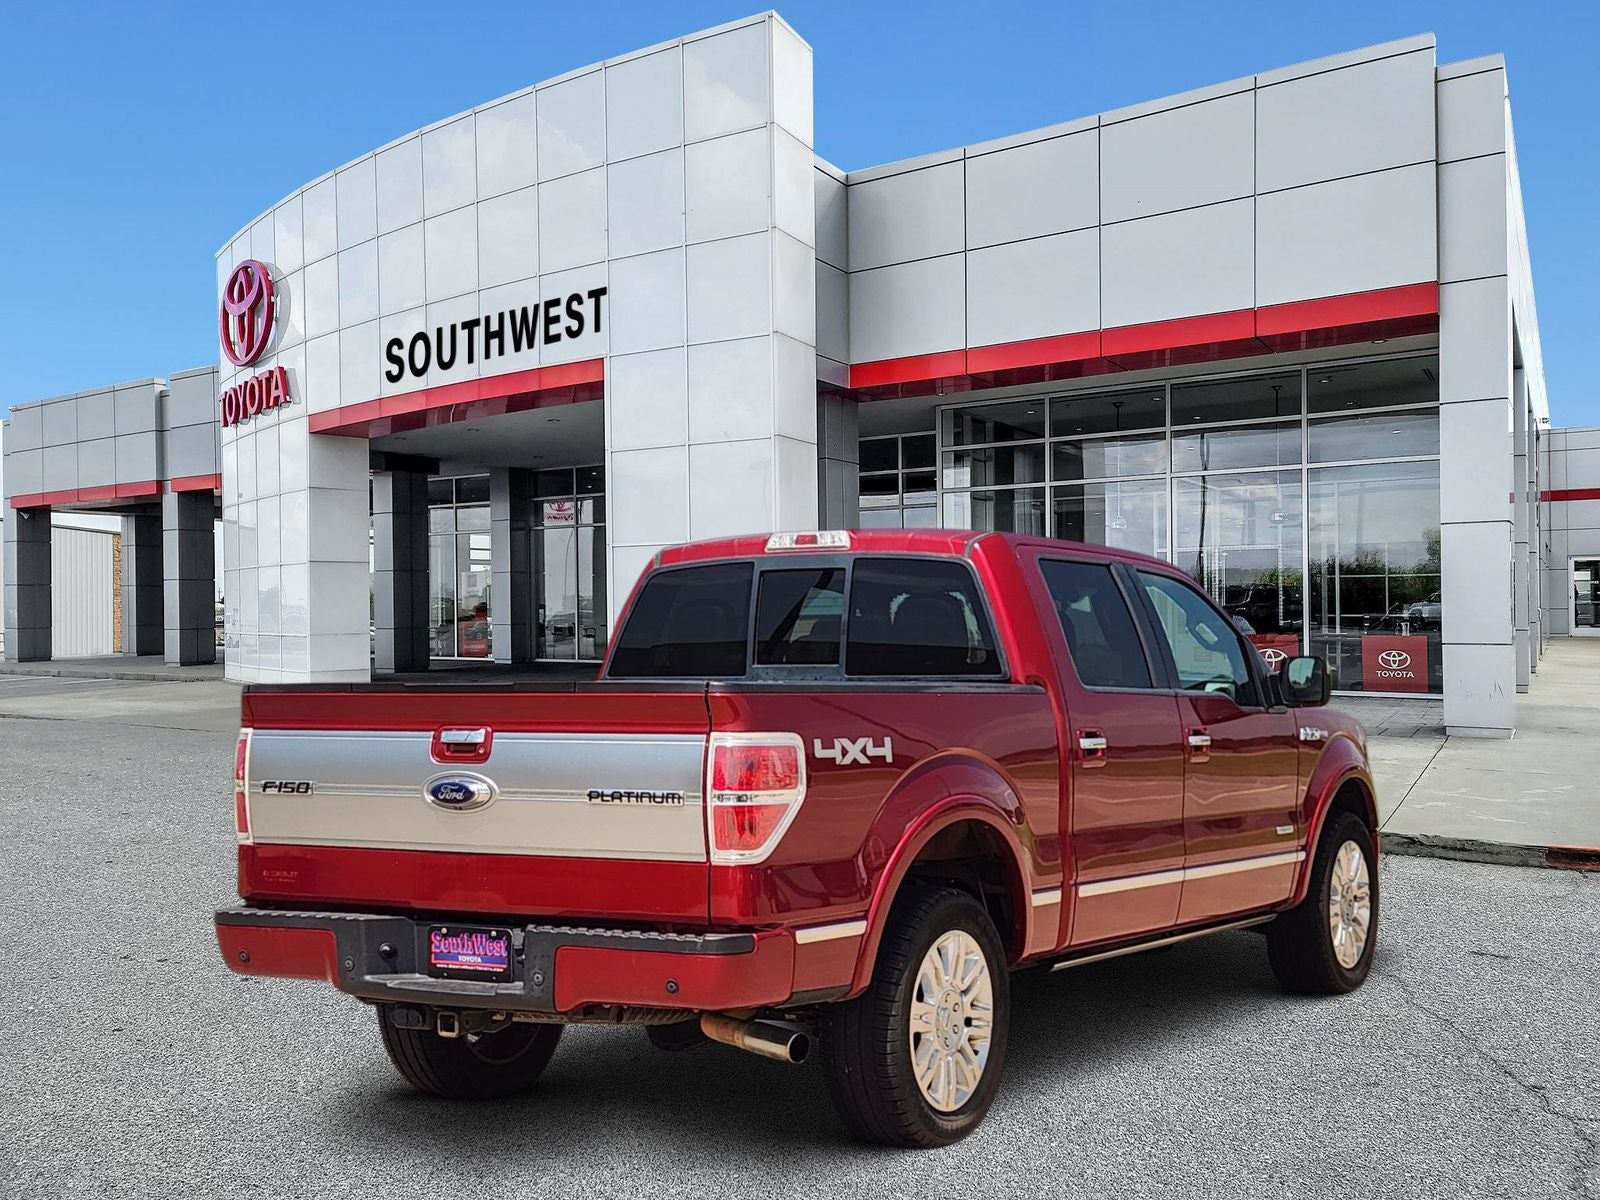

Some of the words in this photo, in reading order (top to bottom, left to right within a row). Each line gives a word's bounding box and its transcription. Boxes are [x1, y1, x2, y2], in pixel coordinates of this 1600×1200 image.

[385, 286, 608, 384] SOUTHWEST
[218, 366, 290, 427] TOYOTA
[1375, 670, 1415, 678] TOYOTA
[262, 781, 311, 794] F-150
[437, 784, 466, 800] Ford
[586, 790, 683, 804] PLATINUM
[457, 954, 482, 963] TOYOTA
